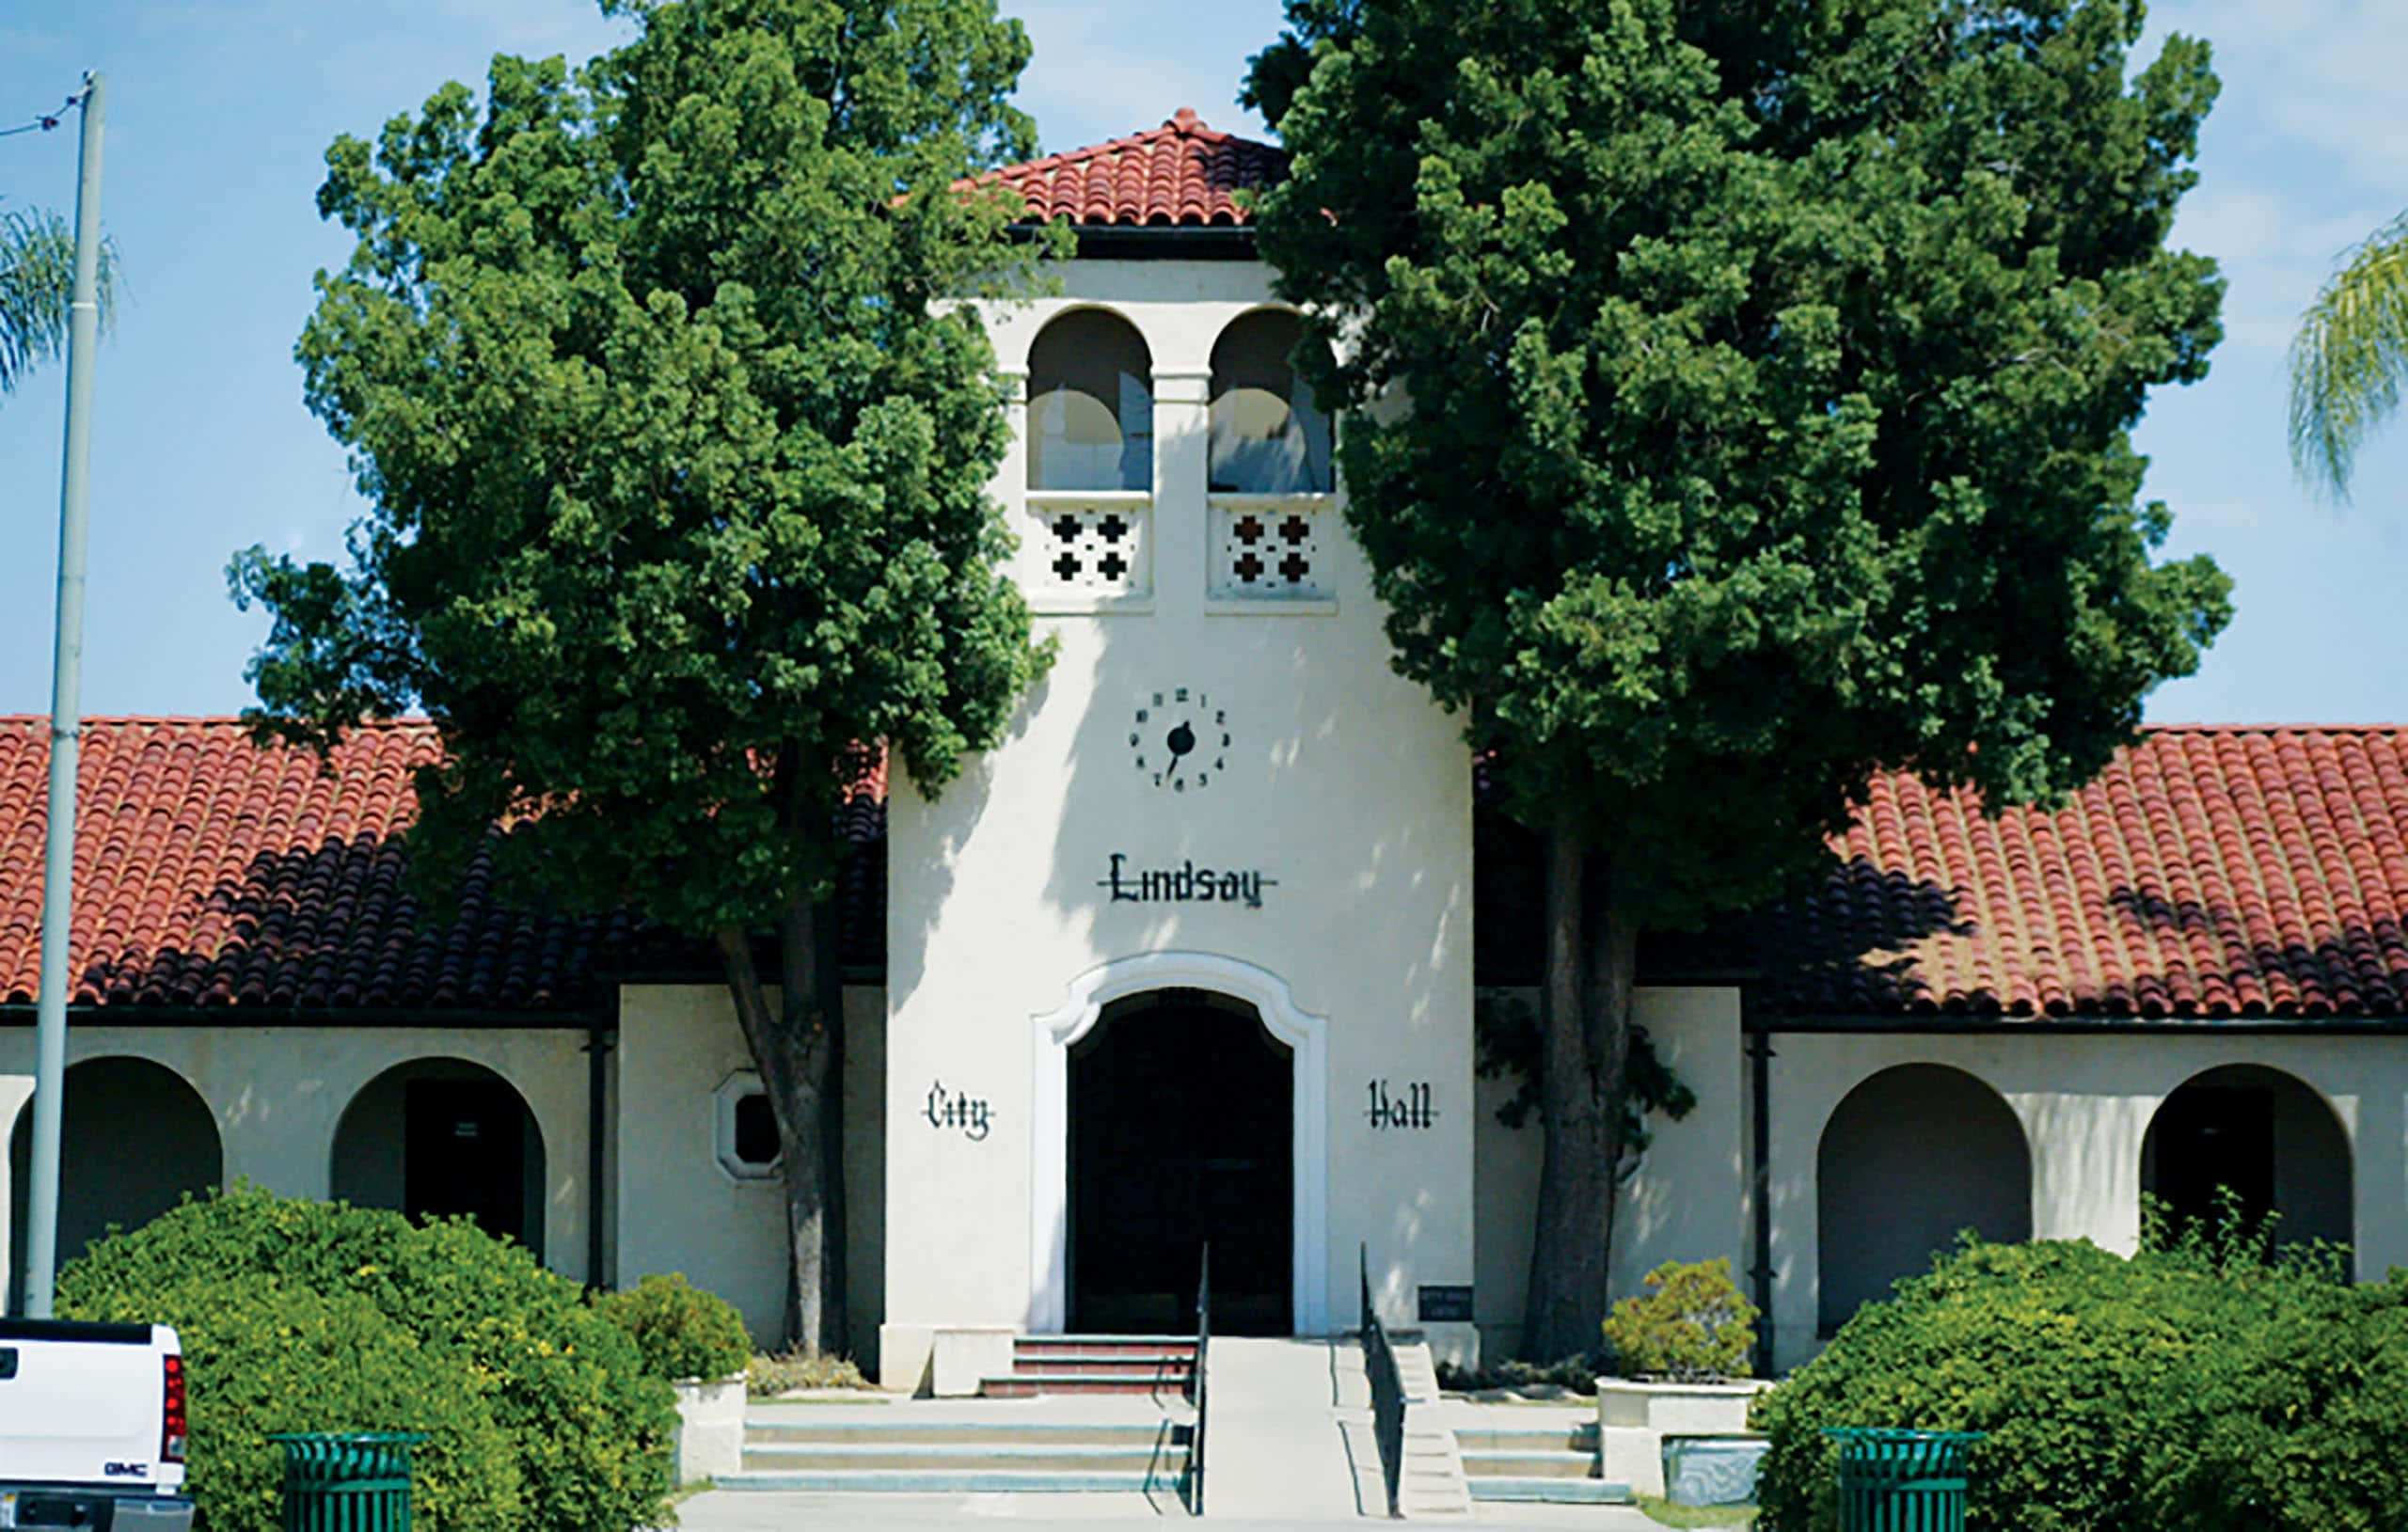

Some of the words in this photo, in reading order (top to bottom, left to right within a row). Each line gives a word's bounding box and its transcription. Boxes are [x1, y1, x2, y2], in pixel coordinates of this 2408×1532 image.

[1108, 852, 1264, 909] Lindsay
[926, 1078, 991, 1143] City
[1367, 1078, 1434, 1131] Hall
[104, 1461, 148, 1477] GMC
